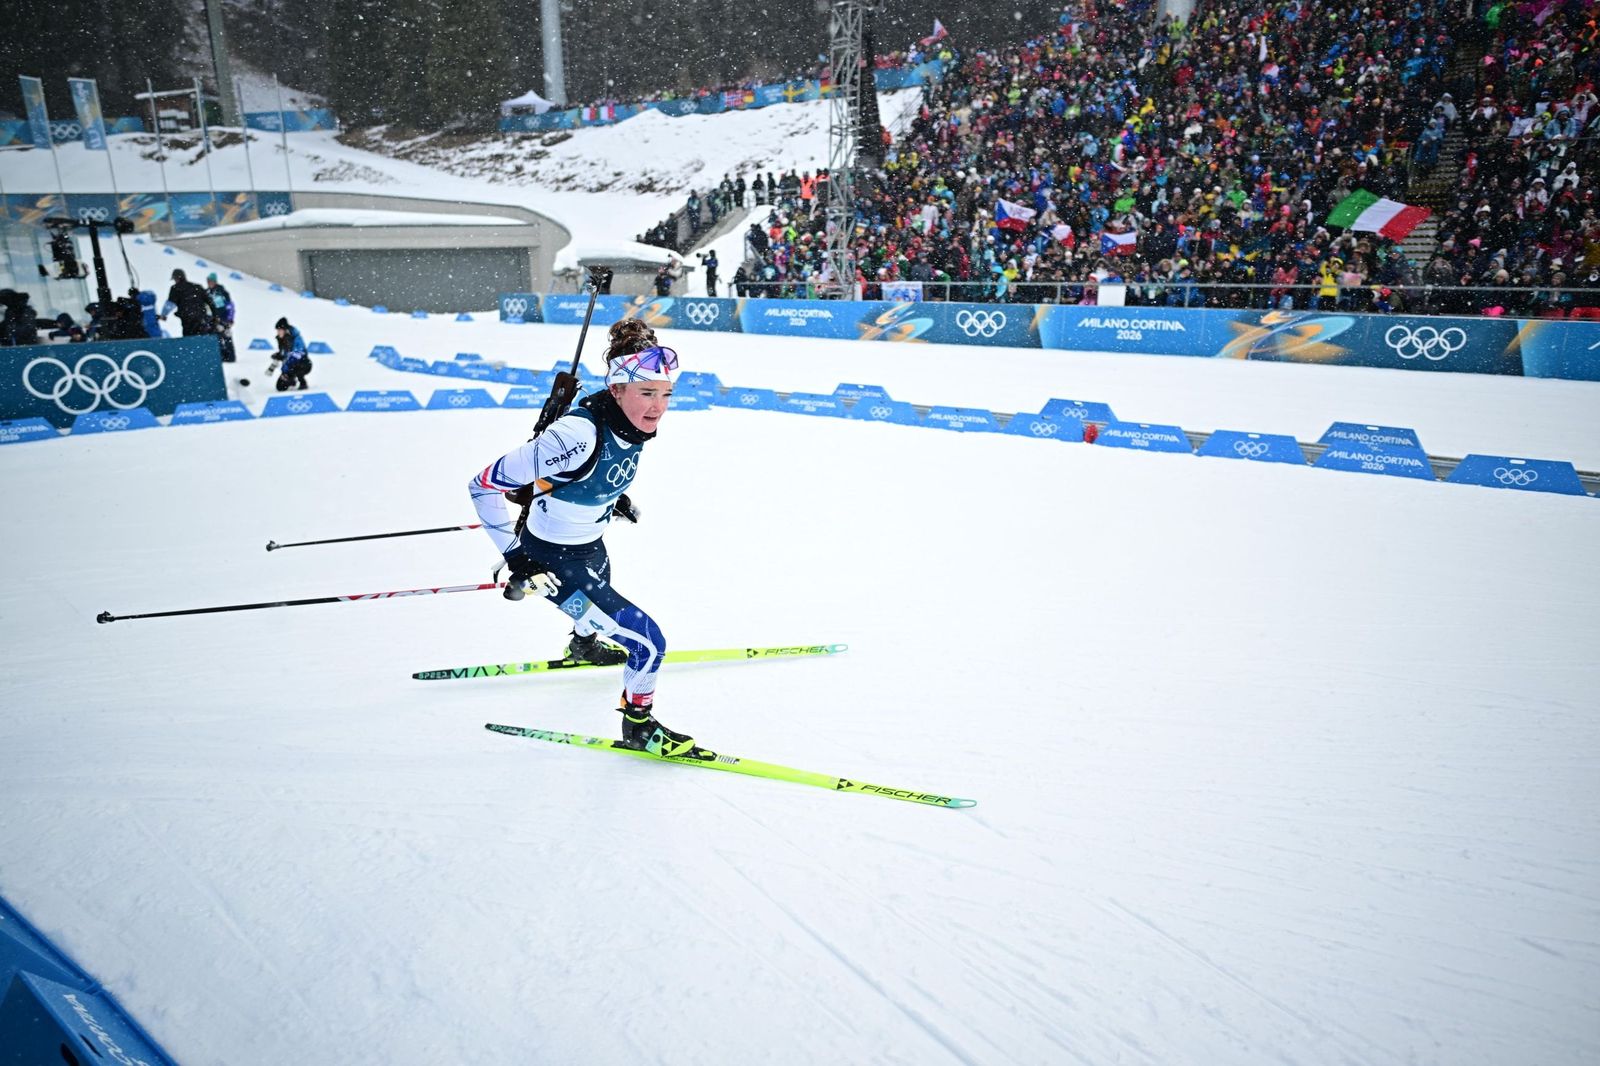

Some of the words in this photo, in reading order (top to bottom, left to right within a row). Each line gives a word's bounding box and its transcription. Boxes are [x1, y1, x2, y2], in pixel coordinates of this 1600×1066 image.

[764, 308, 797, 317] MILANO
[799, 309, 834, 319] CORTINA
[1078, 318, 1129, 329] MILANO
[1130, 319, 1186, 332] CORTINA
[1116, 330, 1142, 341] 2026
[1104, 429, 1140, 439] MILANO
[1142, 432, 1180, 443] CORTINA
[1328, 430, 1369, 441] MILANO
[1370, 434, 1414, 446] CORTINA
[545, 447, 579, 466] CRAFT
[1327, 450, 1374, 462] MILANO
[1375, 455, 1424, 467] CORTINA
[1361, 461, 1385, 471] 2026
[589, 619, 604, 631] 4
[765, 645, 829, 655] FISCHER
[860, 784, 951, 804] FISCHER
